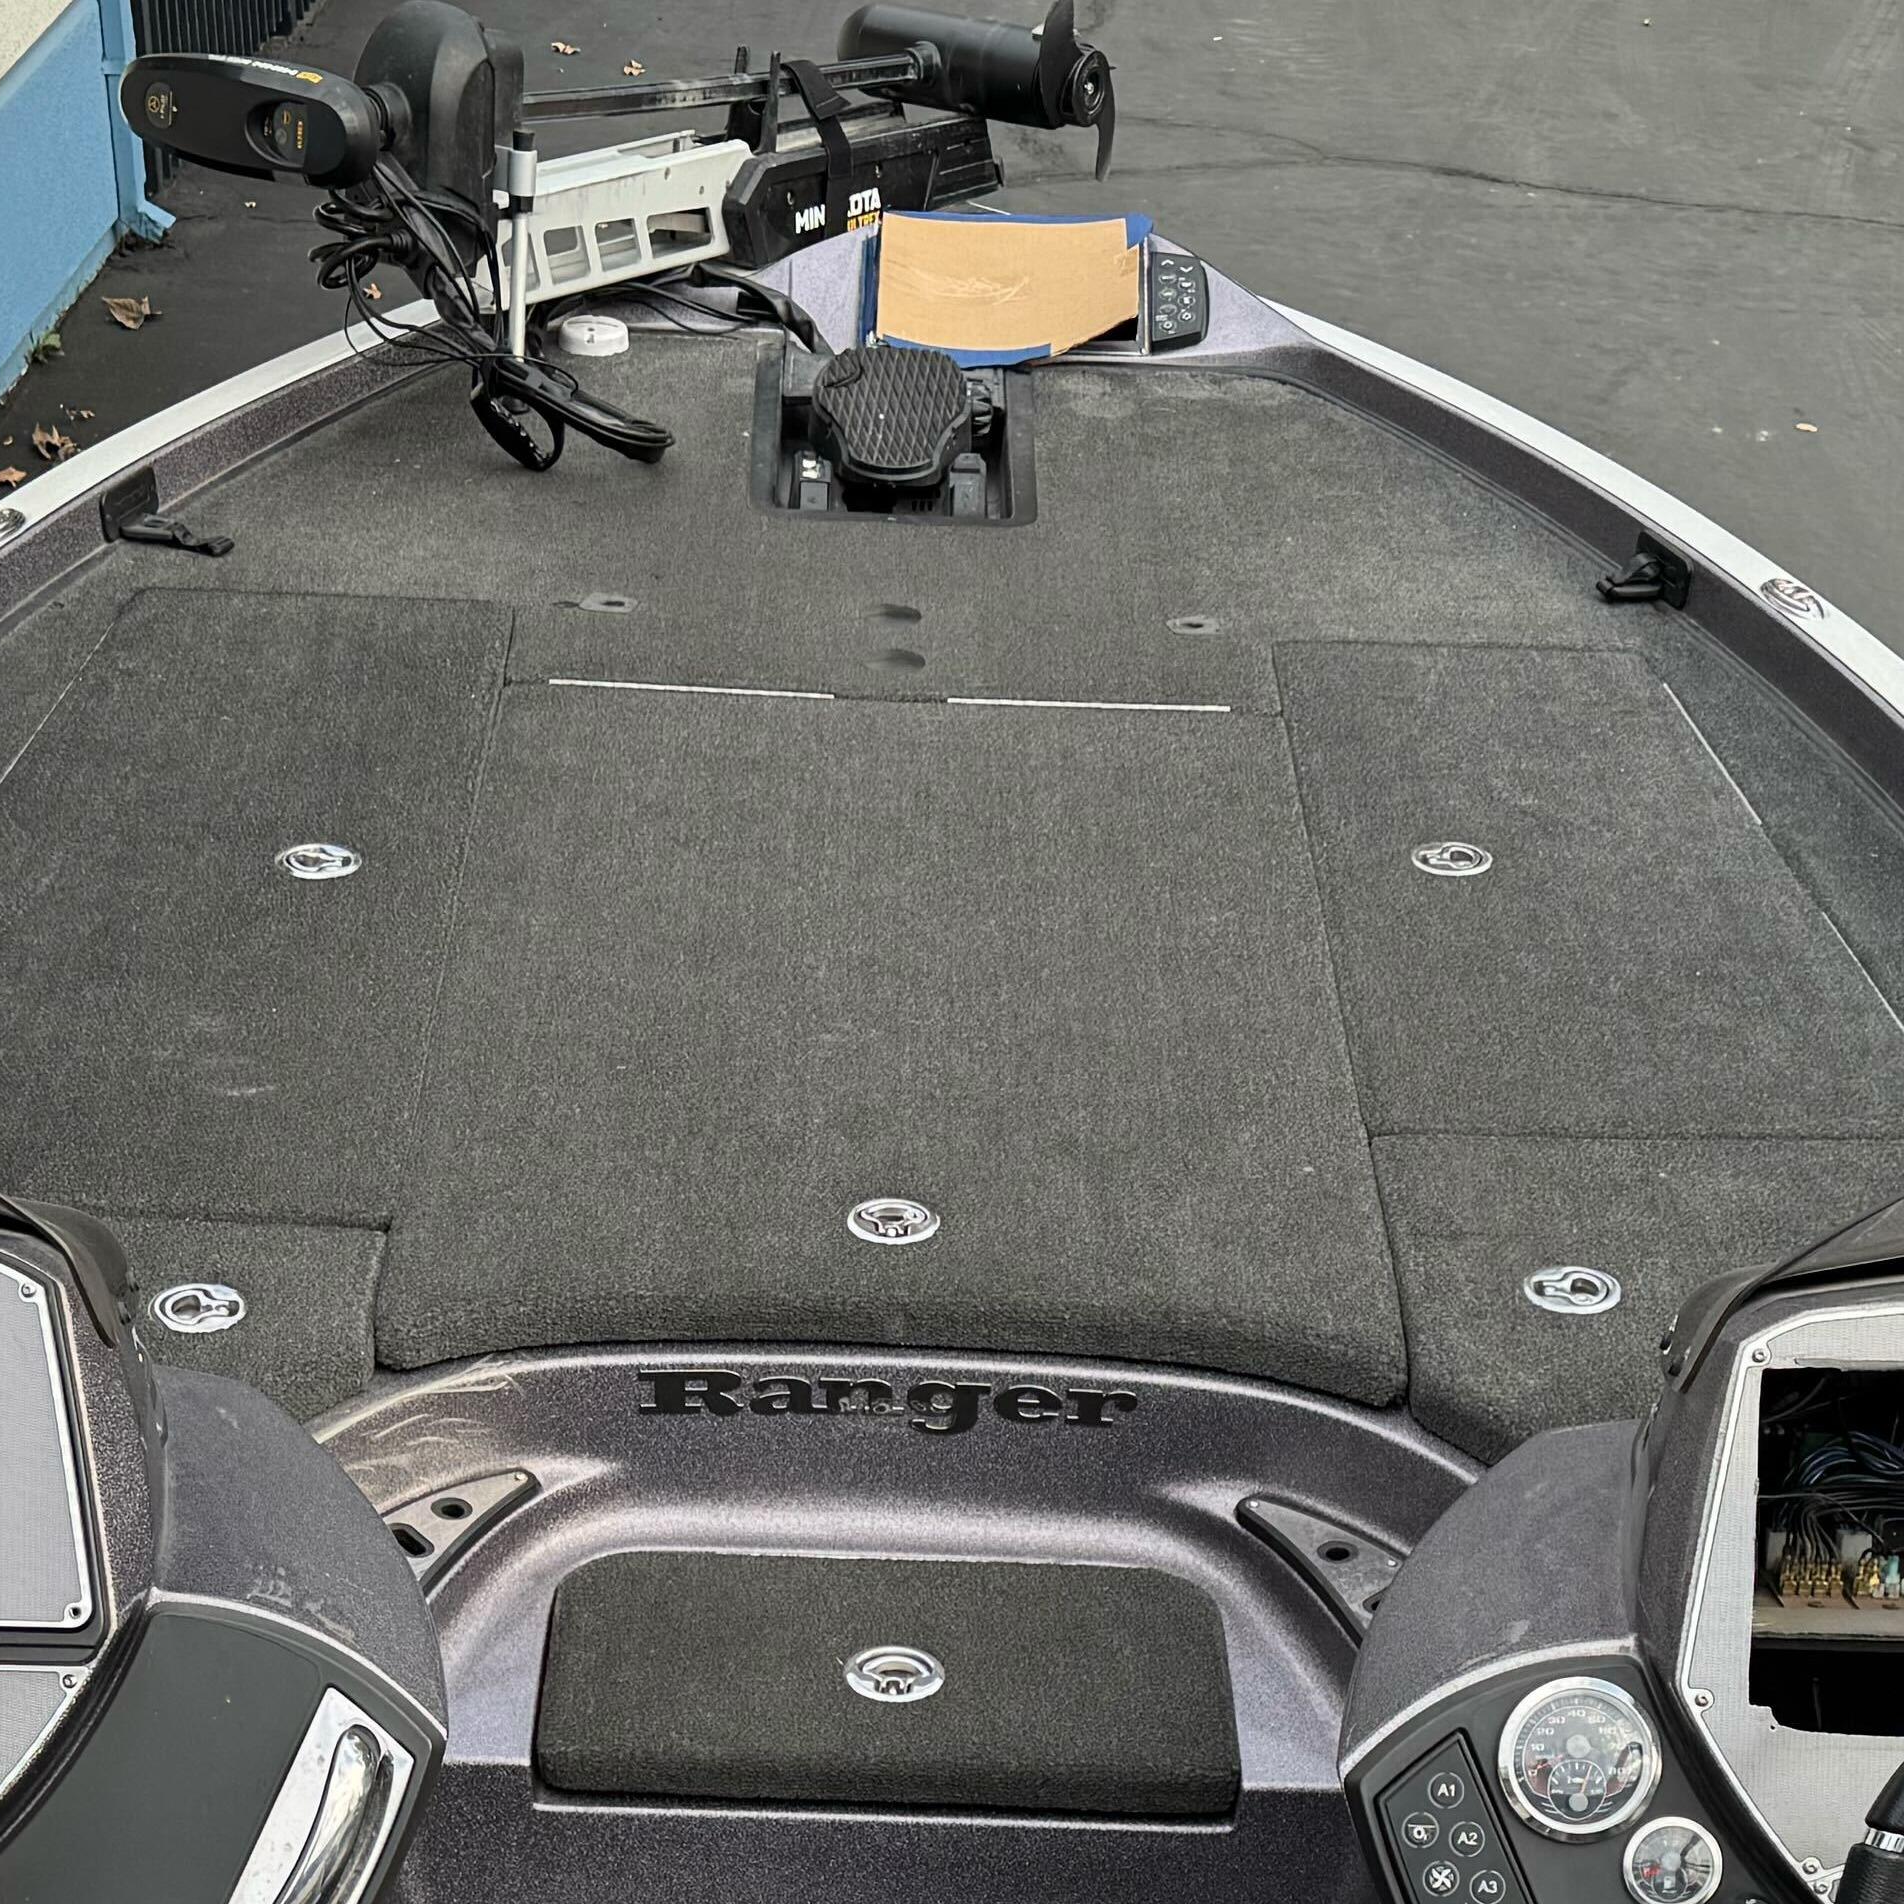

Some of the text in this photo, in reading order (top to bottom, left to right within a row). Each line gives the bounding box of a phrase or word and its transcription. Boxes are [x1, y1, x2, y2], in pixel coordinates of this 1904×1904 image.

[796, 187, 881, 234] MIN OTA
[639, 1368, 1138, 1435] Ranger
[1437, 1784, 1456, 1797] A1
[1457, 1832, 1477, 1845] A2
[1477, 1881, 1498, 1894] A3
